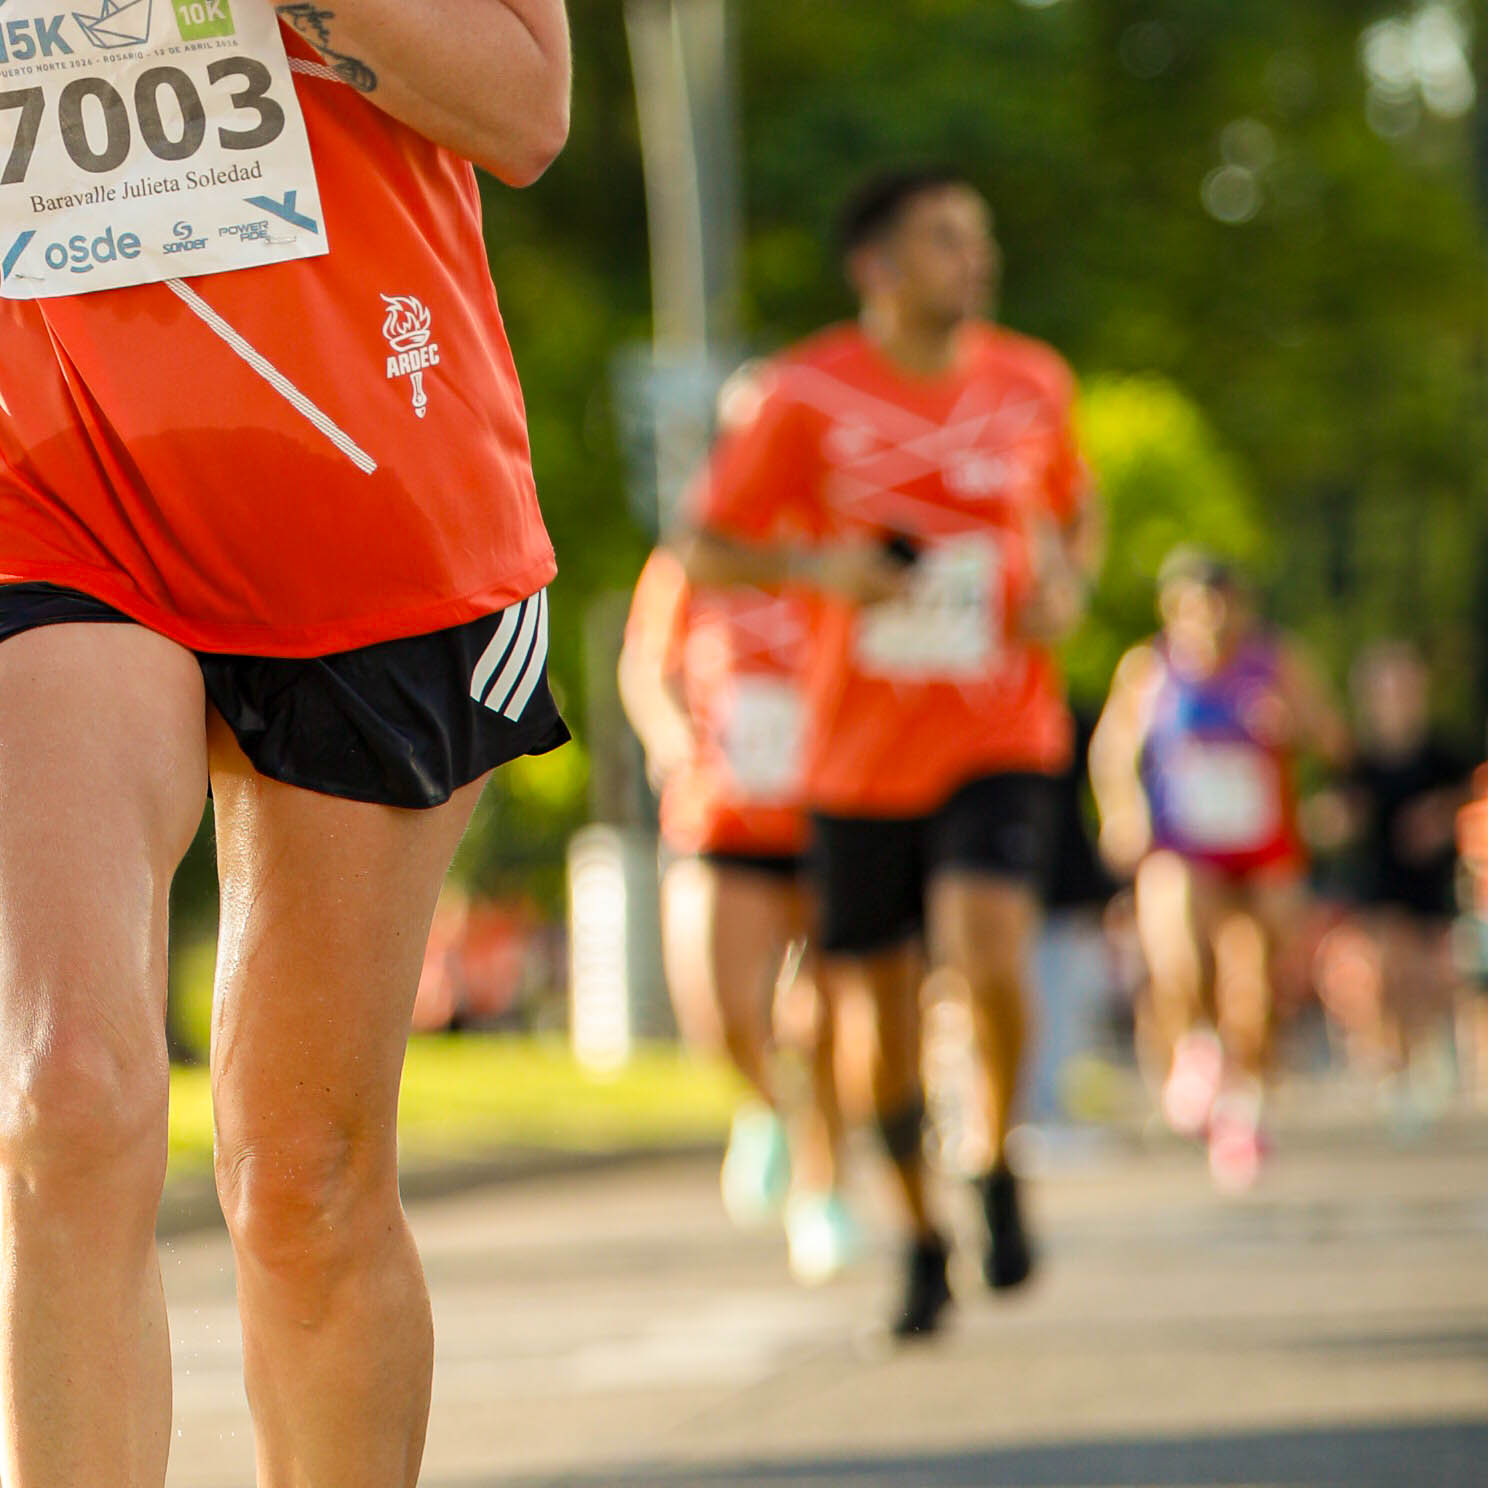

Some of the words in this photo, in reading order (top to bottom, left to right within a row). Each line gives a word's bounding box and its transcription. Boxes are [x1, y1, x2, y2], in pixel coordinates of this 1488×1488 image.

[36, 61, 67, 73] NORTE
[103, 51, 144, 64] ROSARIO
[168, 45, 181, 55] DE
[184, 41, 213, 53] ABRIL
[30, 185, 116, 213] Baravalle
[121, 175, 180, 200] Julieta
[185, 160, 263, 190] Soledad
[218, 220, 269, 237] POWER
[45, 225, 141, 272] osde
[386, 343, 440, 379] ARDEC
